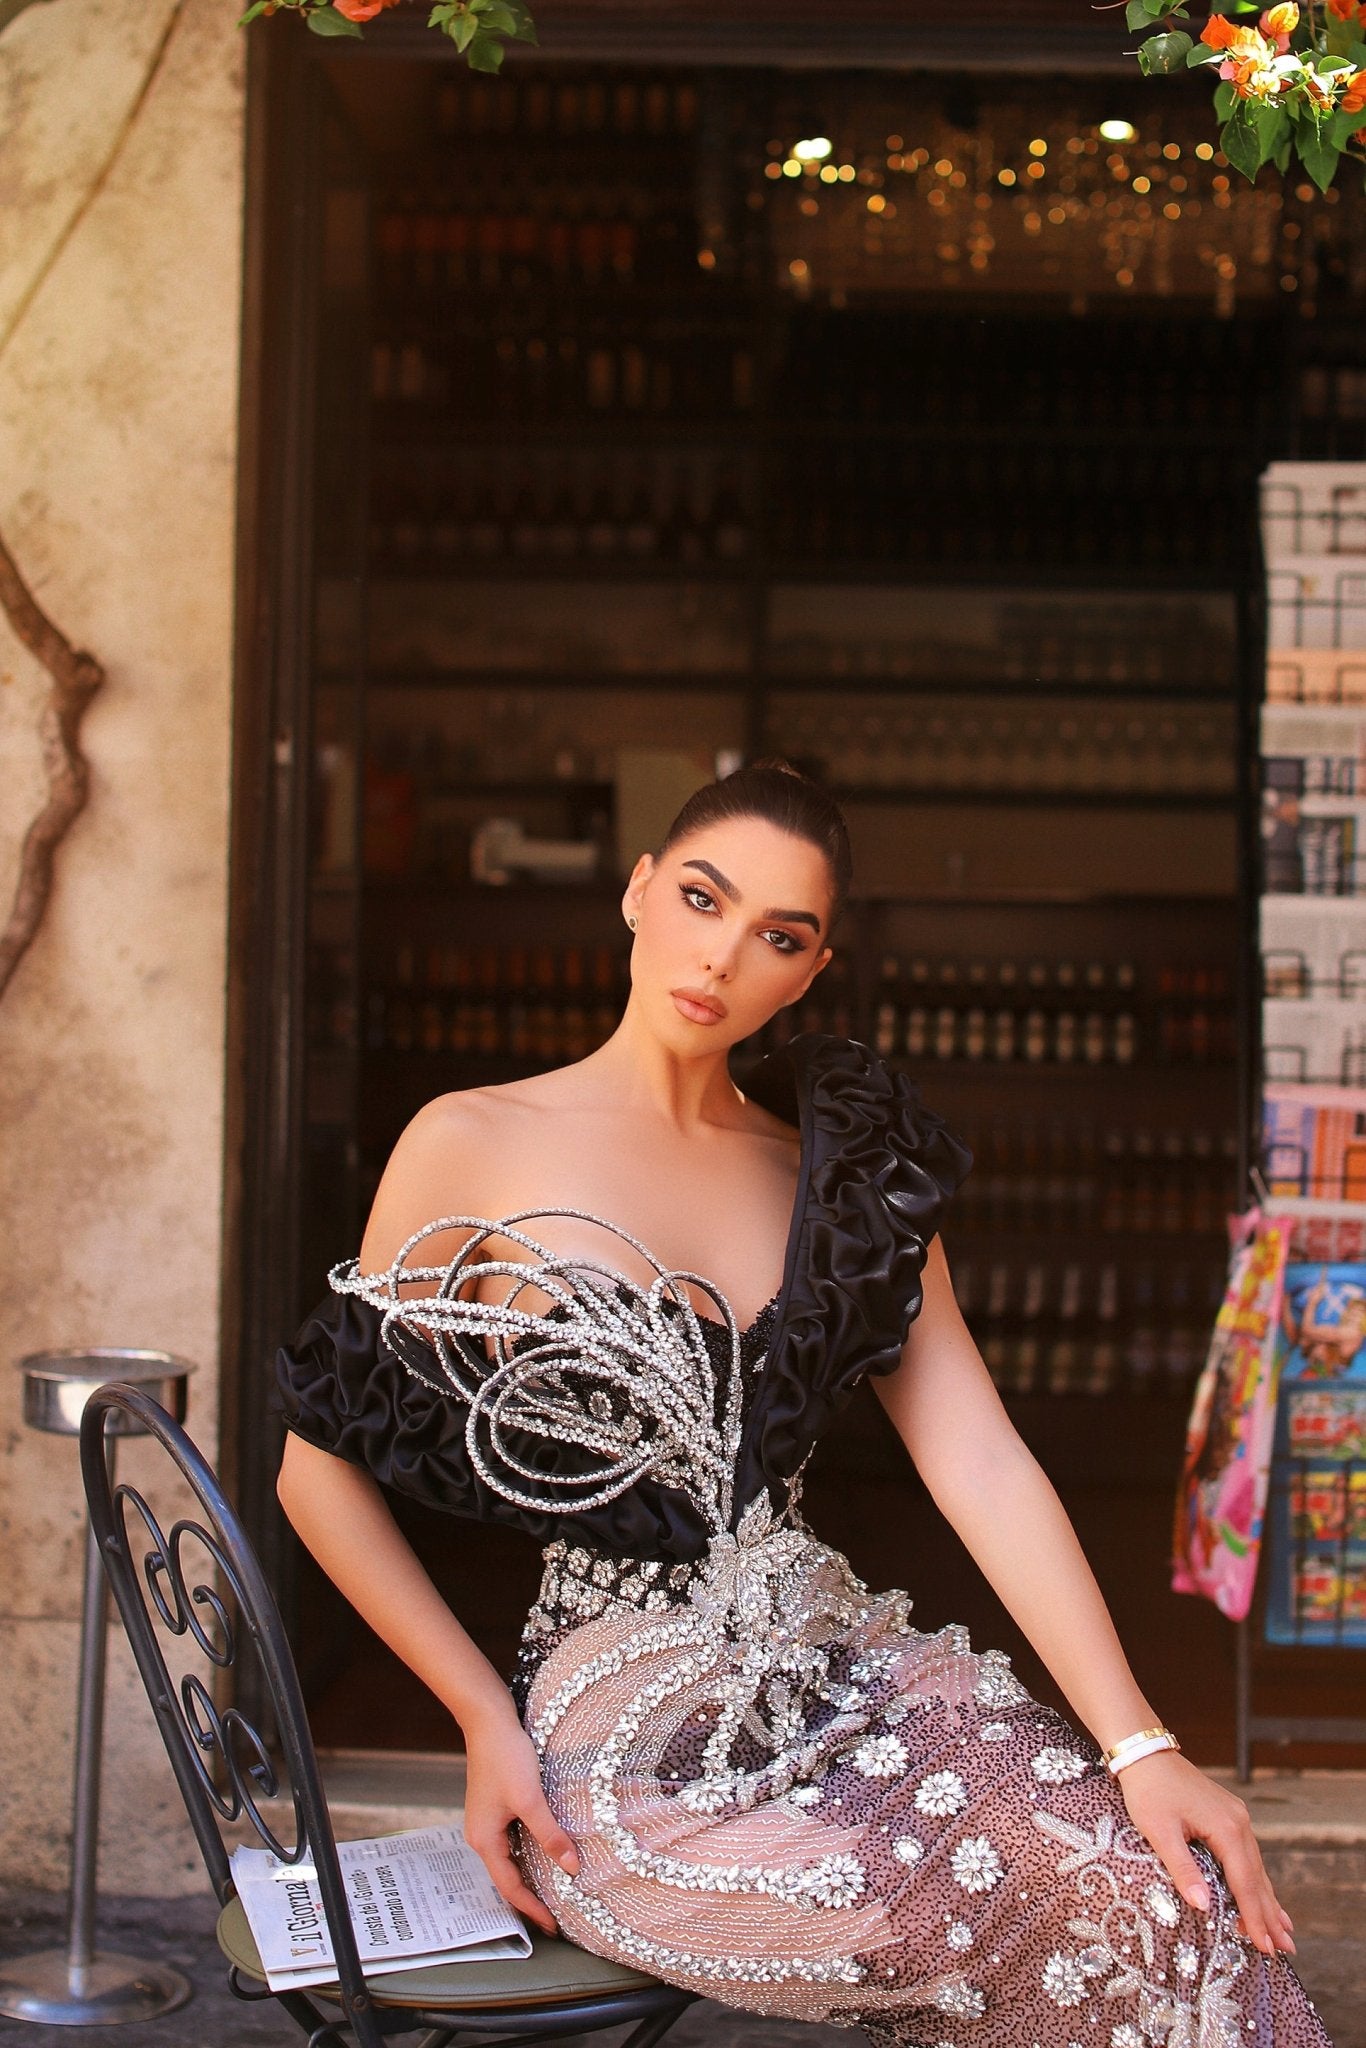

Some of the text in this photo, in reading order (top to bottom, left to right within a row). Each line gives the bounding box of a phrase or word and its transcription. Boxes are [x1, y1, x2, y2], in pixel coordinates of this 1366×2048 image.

[357, 1902, 380, 1915] del
[375, 1865, 414, 1942] condannato al carcere
[290, 1931, 323, 1942] il
[363, 1915, 390, 1947] Cronista
